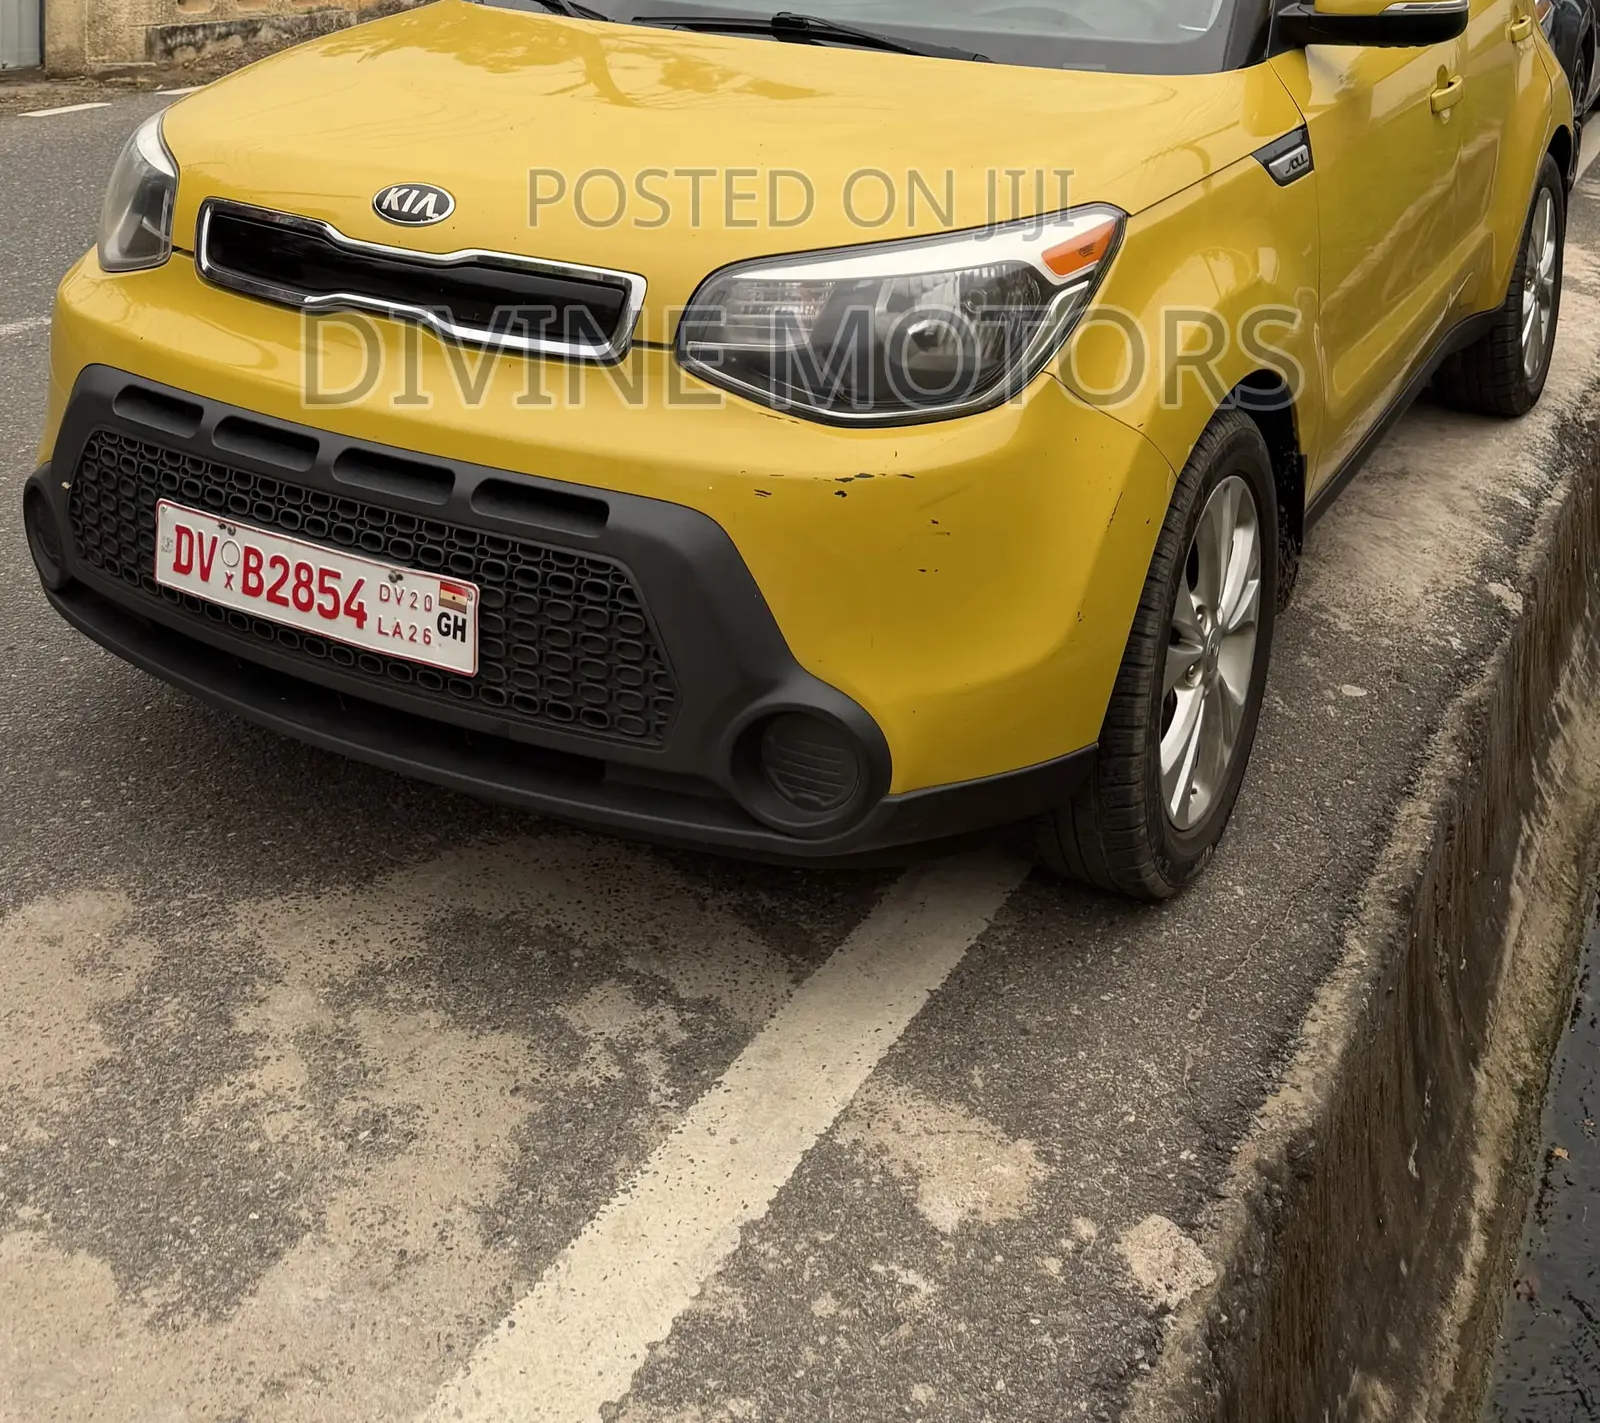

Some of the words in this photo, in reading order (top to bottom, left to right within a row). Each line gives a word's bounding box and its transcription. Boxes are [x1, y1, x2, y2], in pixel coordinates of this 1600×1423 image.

[381, 187, 440, 219] KIA
[173, 523, 218, 583] DV
[241, 545, 368, 630] B2854
[437, 611, 467, 644] GH
